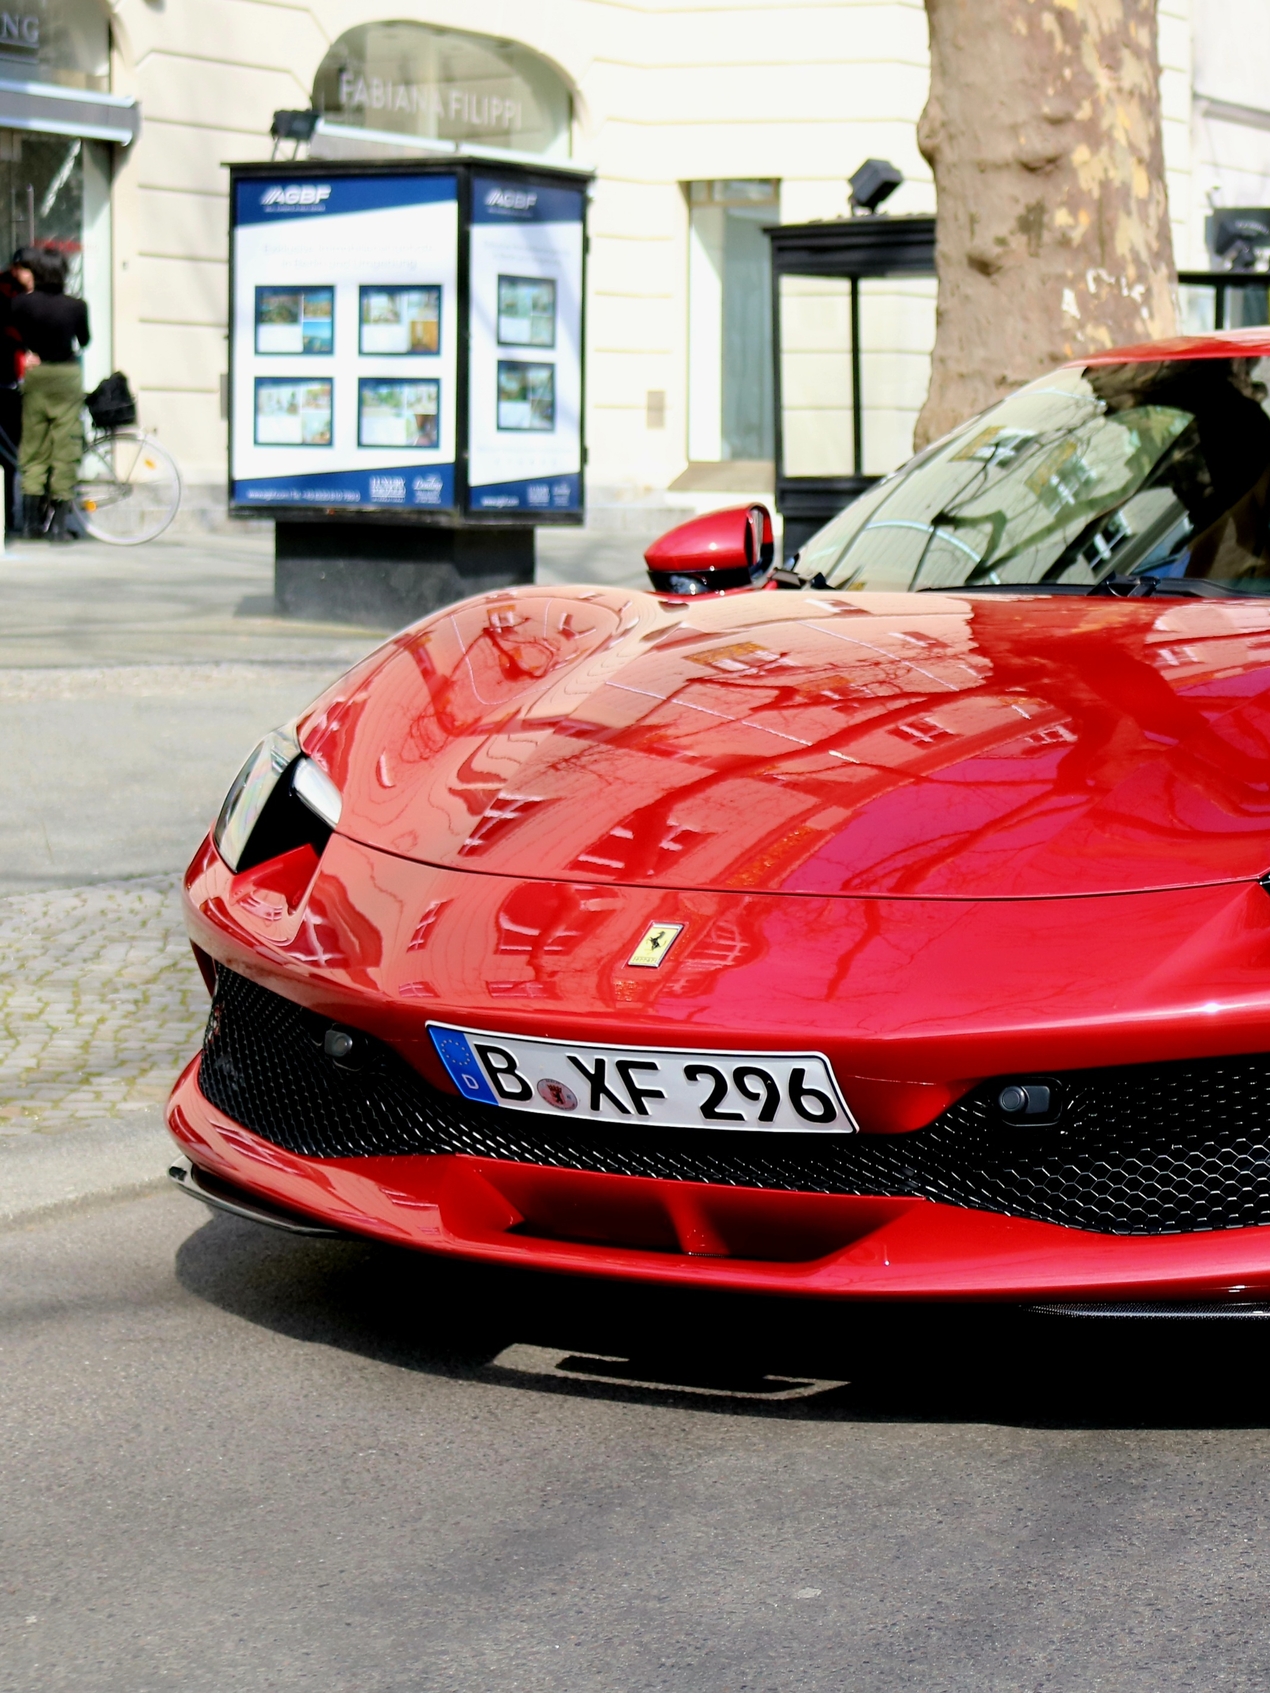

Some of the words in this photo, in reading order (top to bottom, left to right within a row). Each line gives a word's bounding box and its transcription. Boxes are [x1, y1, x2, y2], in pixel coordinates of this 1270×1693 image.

[339, 71, 444, 118] FABIANA
[448, 90, 522, 129] FILIPPI
[461, 1073, 480, 1092] D
[474, 1043, 534, 1102] B
[566, 1055, 666, 1116] XF
[683, 1064, 838, 1124] 296
